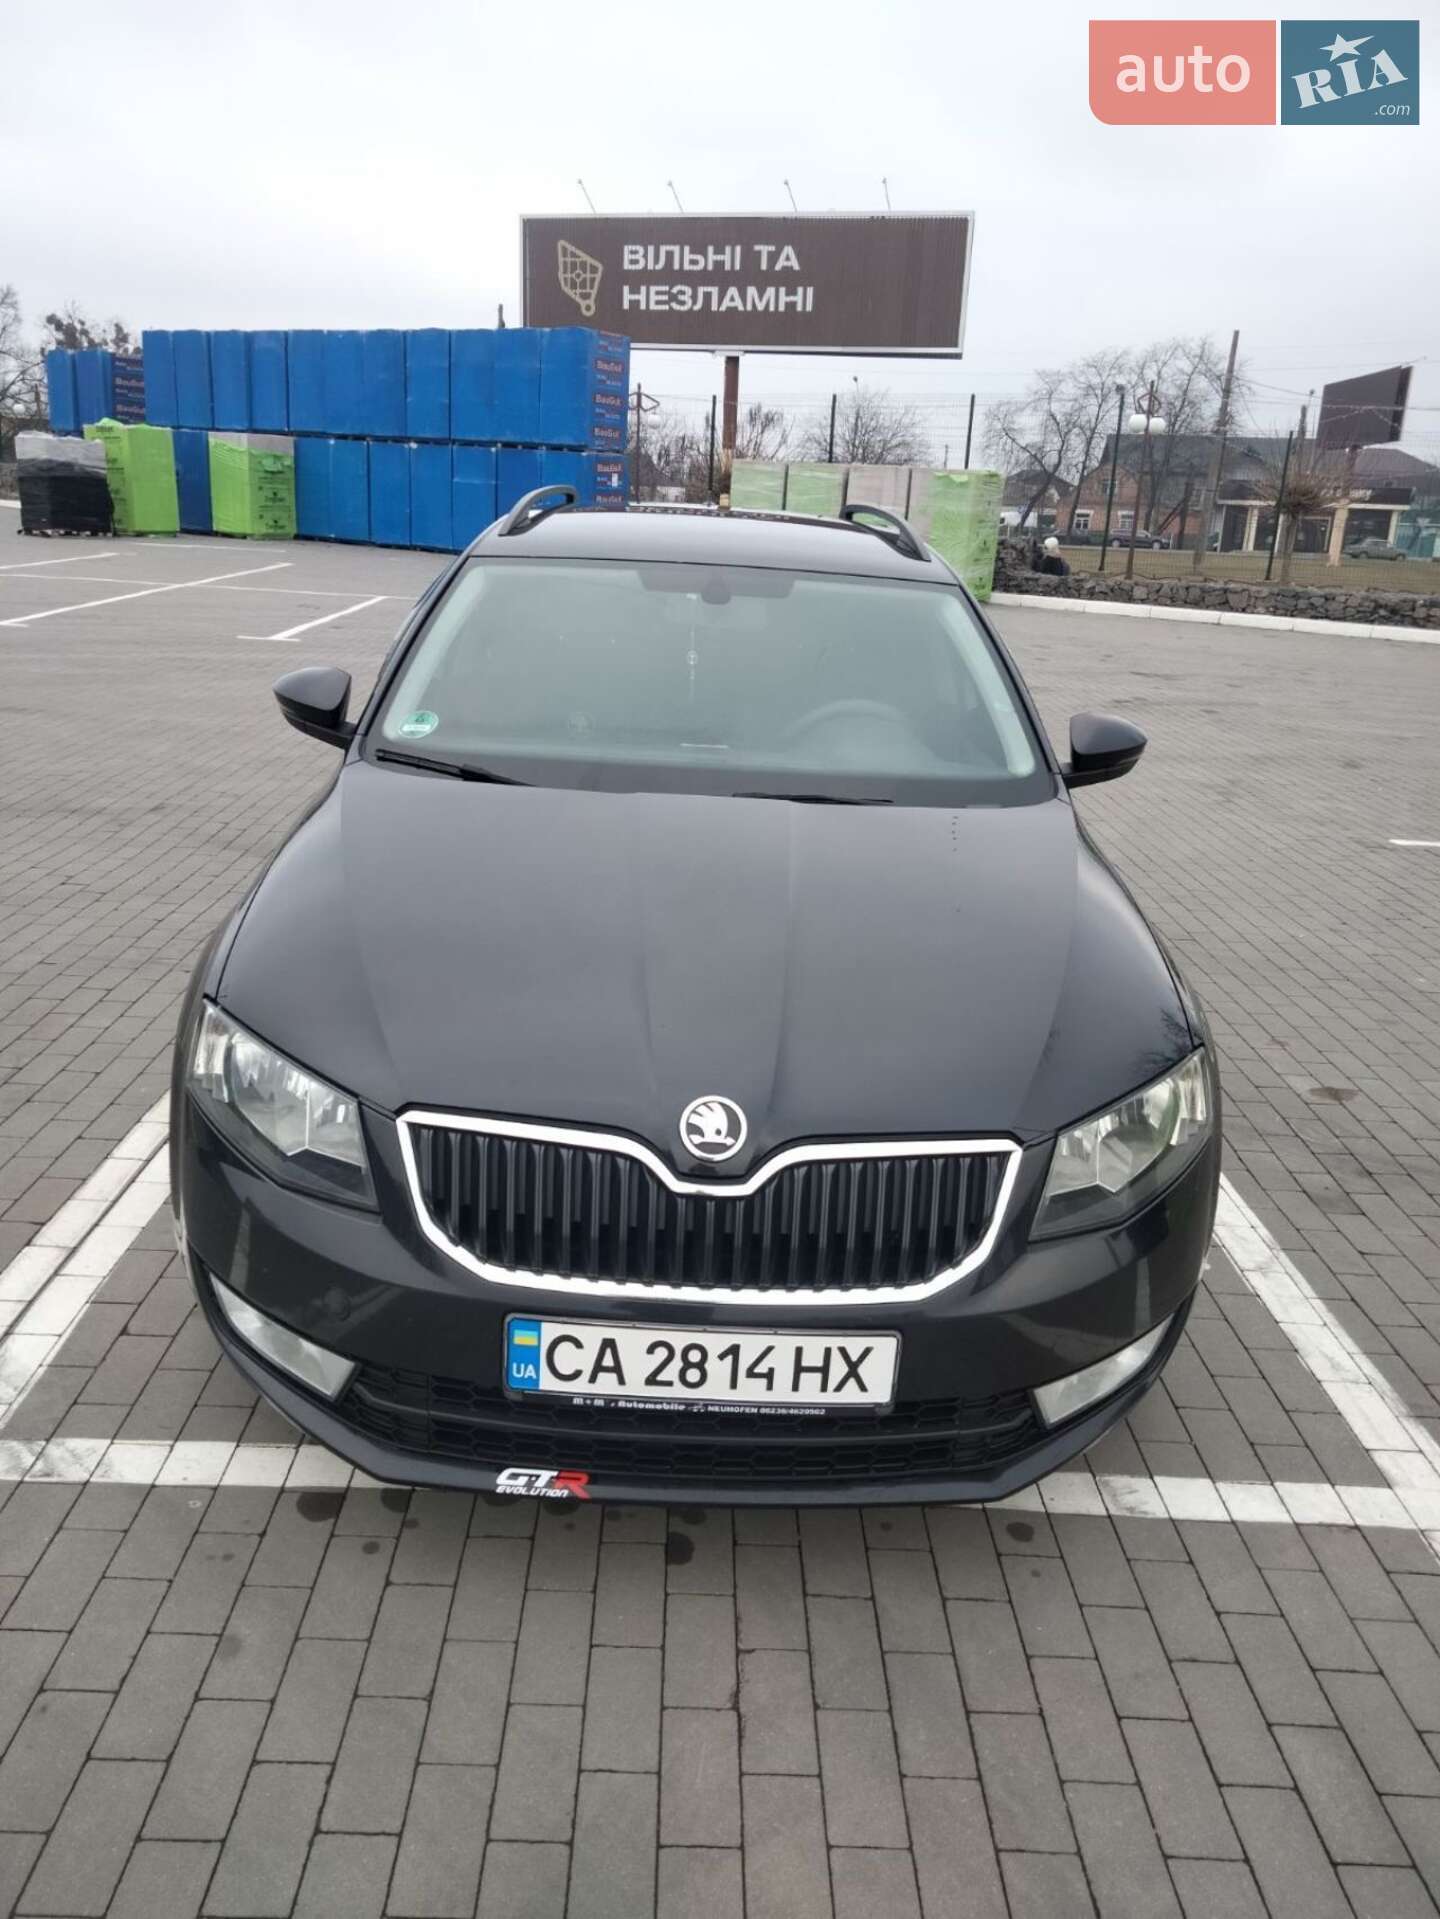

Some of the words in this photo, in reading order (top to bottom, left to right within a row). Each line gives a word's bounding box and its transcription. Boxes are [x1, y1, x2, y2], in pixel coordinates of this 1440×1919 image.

[623, 244, 741, 271] ВІЛЬНІ
[753, 244, 801, 271] ТА
[622, 284, 814, 312] НЕЗЛАМНІ
[512, 1362, 537, 1379] UA
[545, 1334, 626, 1386] CA
[644, 1340, 776, 1391] 2814
[791, 1345, 874, 1392] HX
